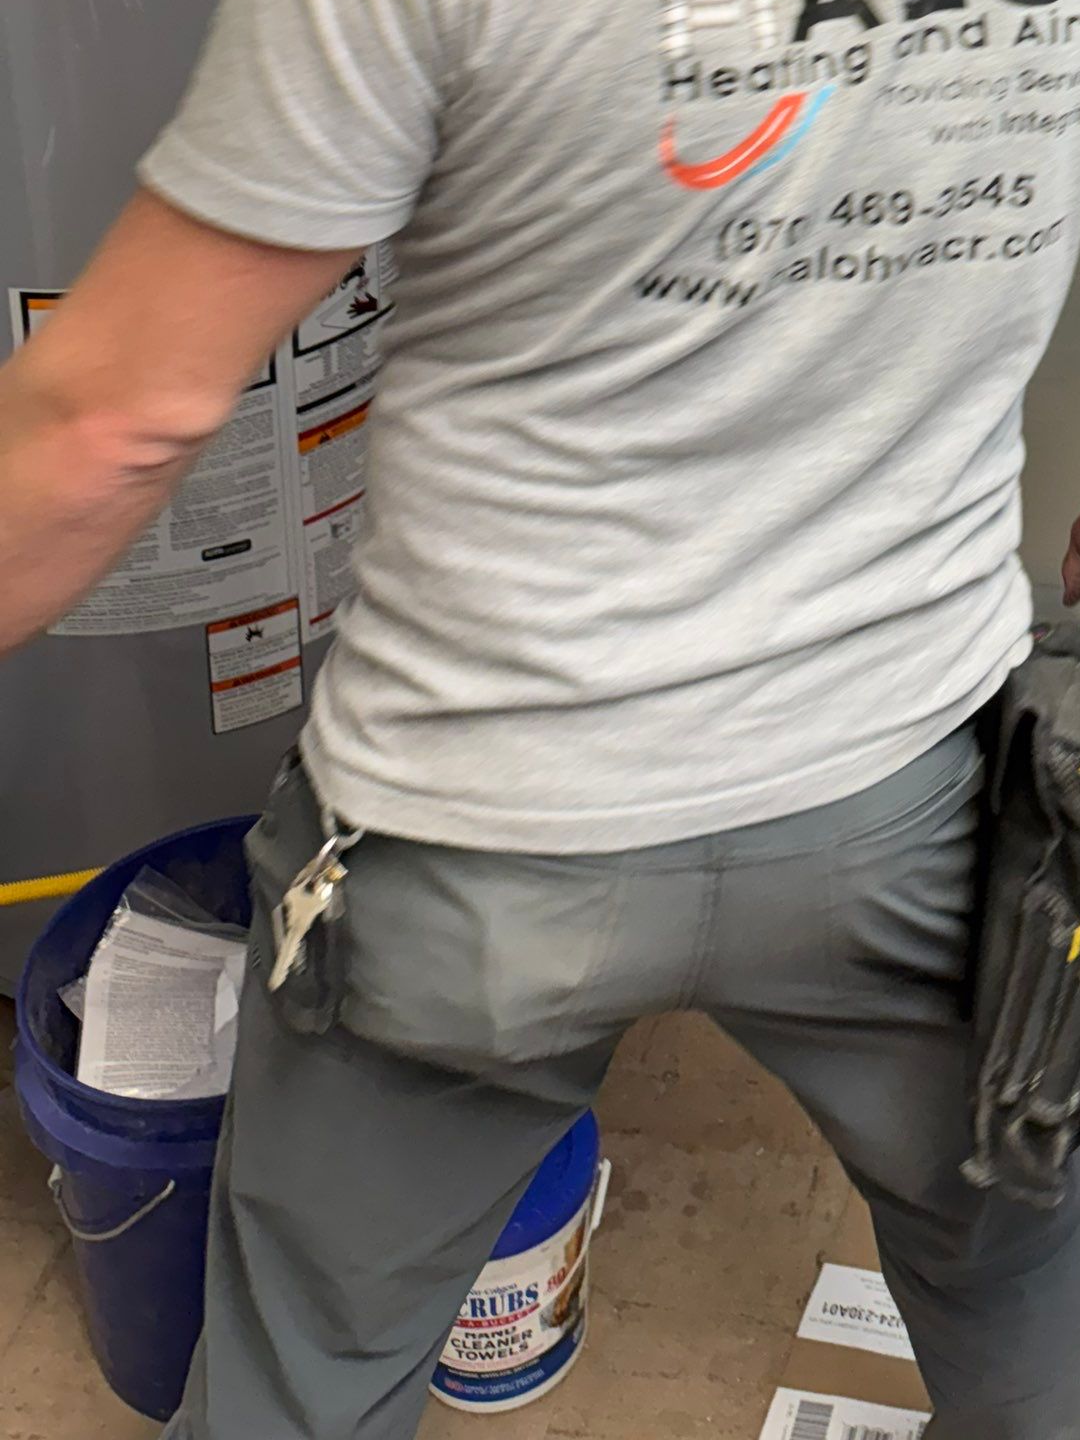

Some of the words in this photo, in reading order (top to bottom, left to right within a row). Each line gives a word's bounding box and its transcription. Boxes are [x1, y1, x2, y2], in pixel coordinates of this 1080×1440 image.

[660, 42, 875, 104] Heating
[894, 12, 990, 61] and
[828, 173, 1036, 228] 469-3545
[450, 1329, 534, 1351] CLEANER
[463, 1326, 517, 1339] HAND
[454, 1341, 530, 1361] TOWELS
